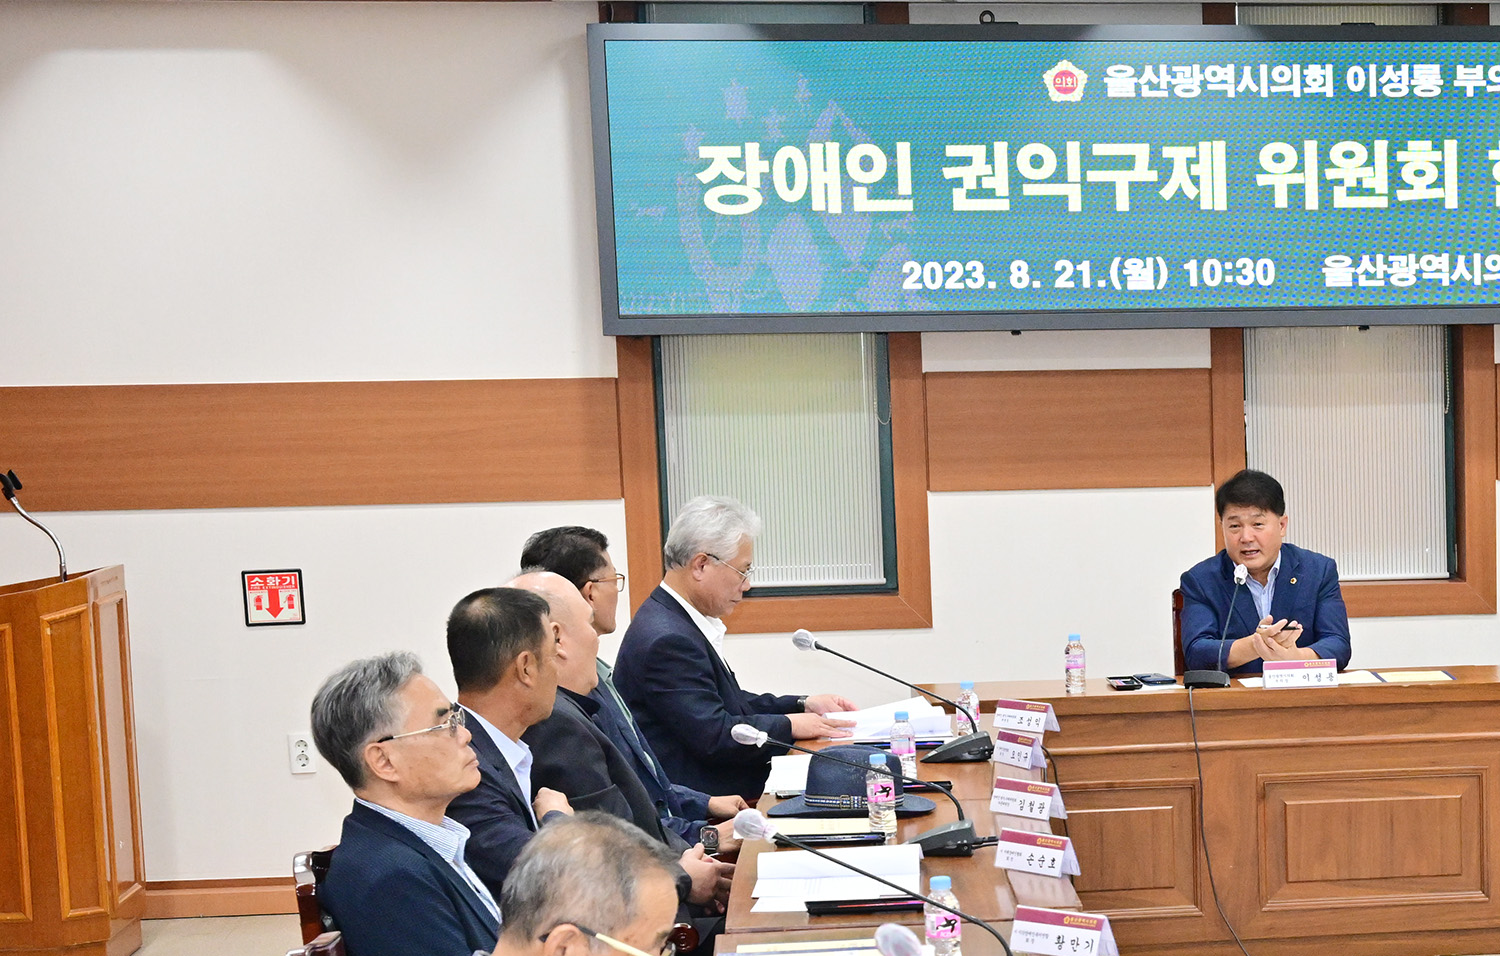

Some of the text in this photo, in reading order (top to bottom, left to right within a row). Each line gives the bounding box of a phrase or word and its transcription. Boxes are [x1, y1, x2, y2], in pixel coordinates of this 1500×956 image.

[1103, 64, 1333, 99] 울산광역시의회
[1346, 64, 1444, 99] 이성룡
[696, 141, 914, 216] 장애인
[942, 140, 1228, 213] 권익구제
[1255, 139, 1460, 212] 위원회
[902, 257, 1276, 291] 2023. 8. 21.(월) 10:30
[251, 576, 296, 586] 소화기
[1054, 934, 1094, 955] 황만기
